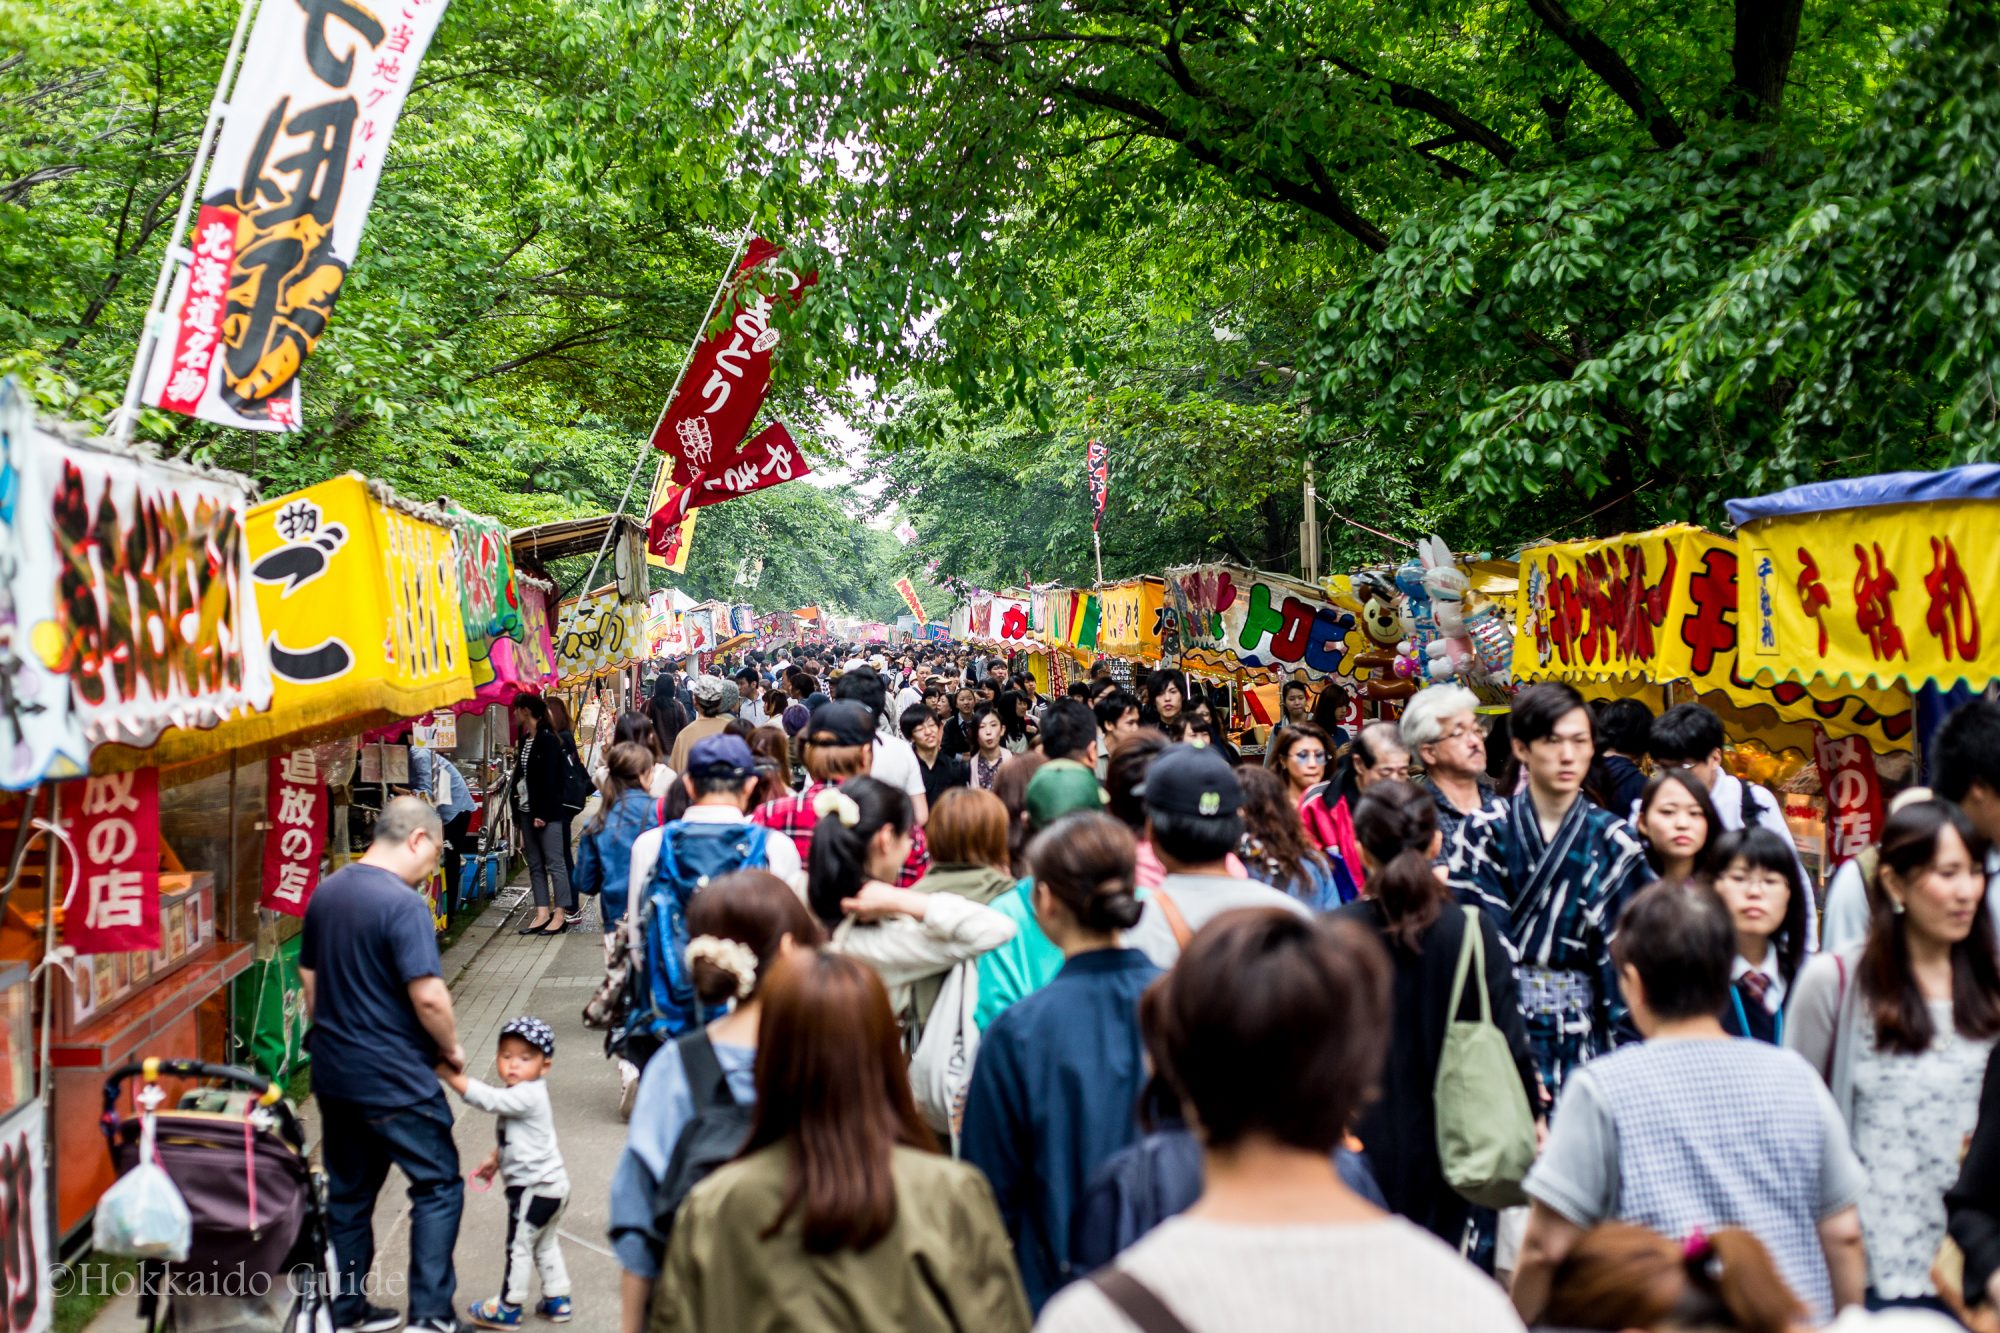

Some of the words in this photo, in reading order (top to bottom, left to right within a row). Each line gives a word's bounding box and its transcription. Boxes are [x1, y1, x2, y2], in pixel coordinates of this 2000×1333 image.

[166, 222, 233, 402] 北海道名物
[280, 503, 318, 539] 物
[272, 749, 318, 904] 追放の店
